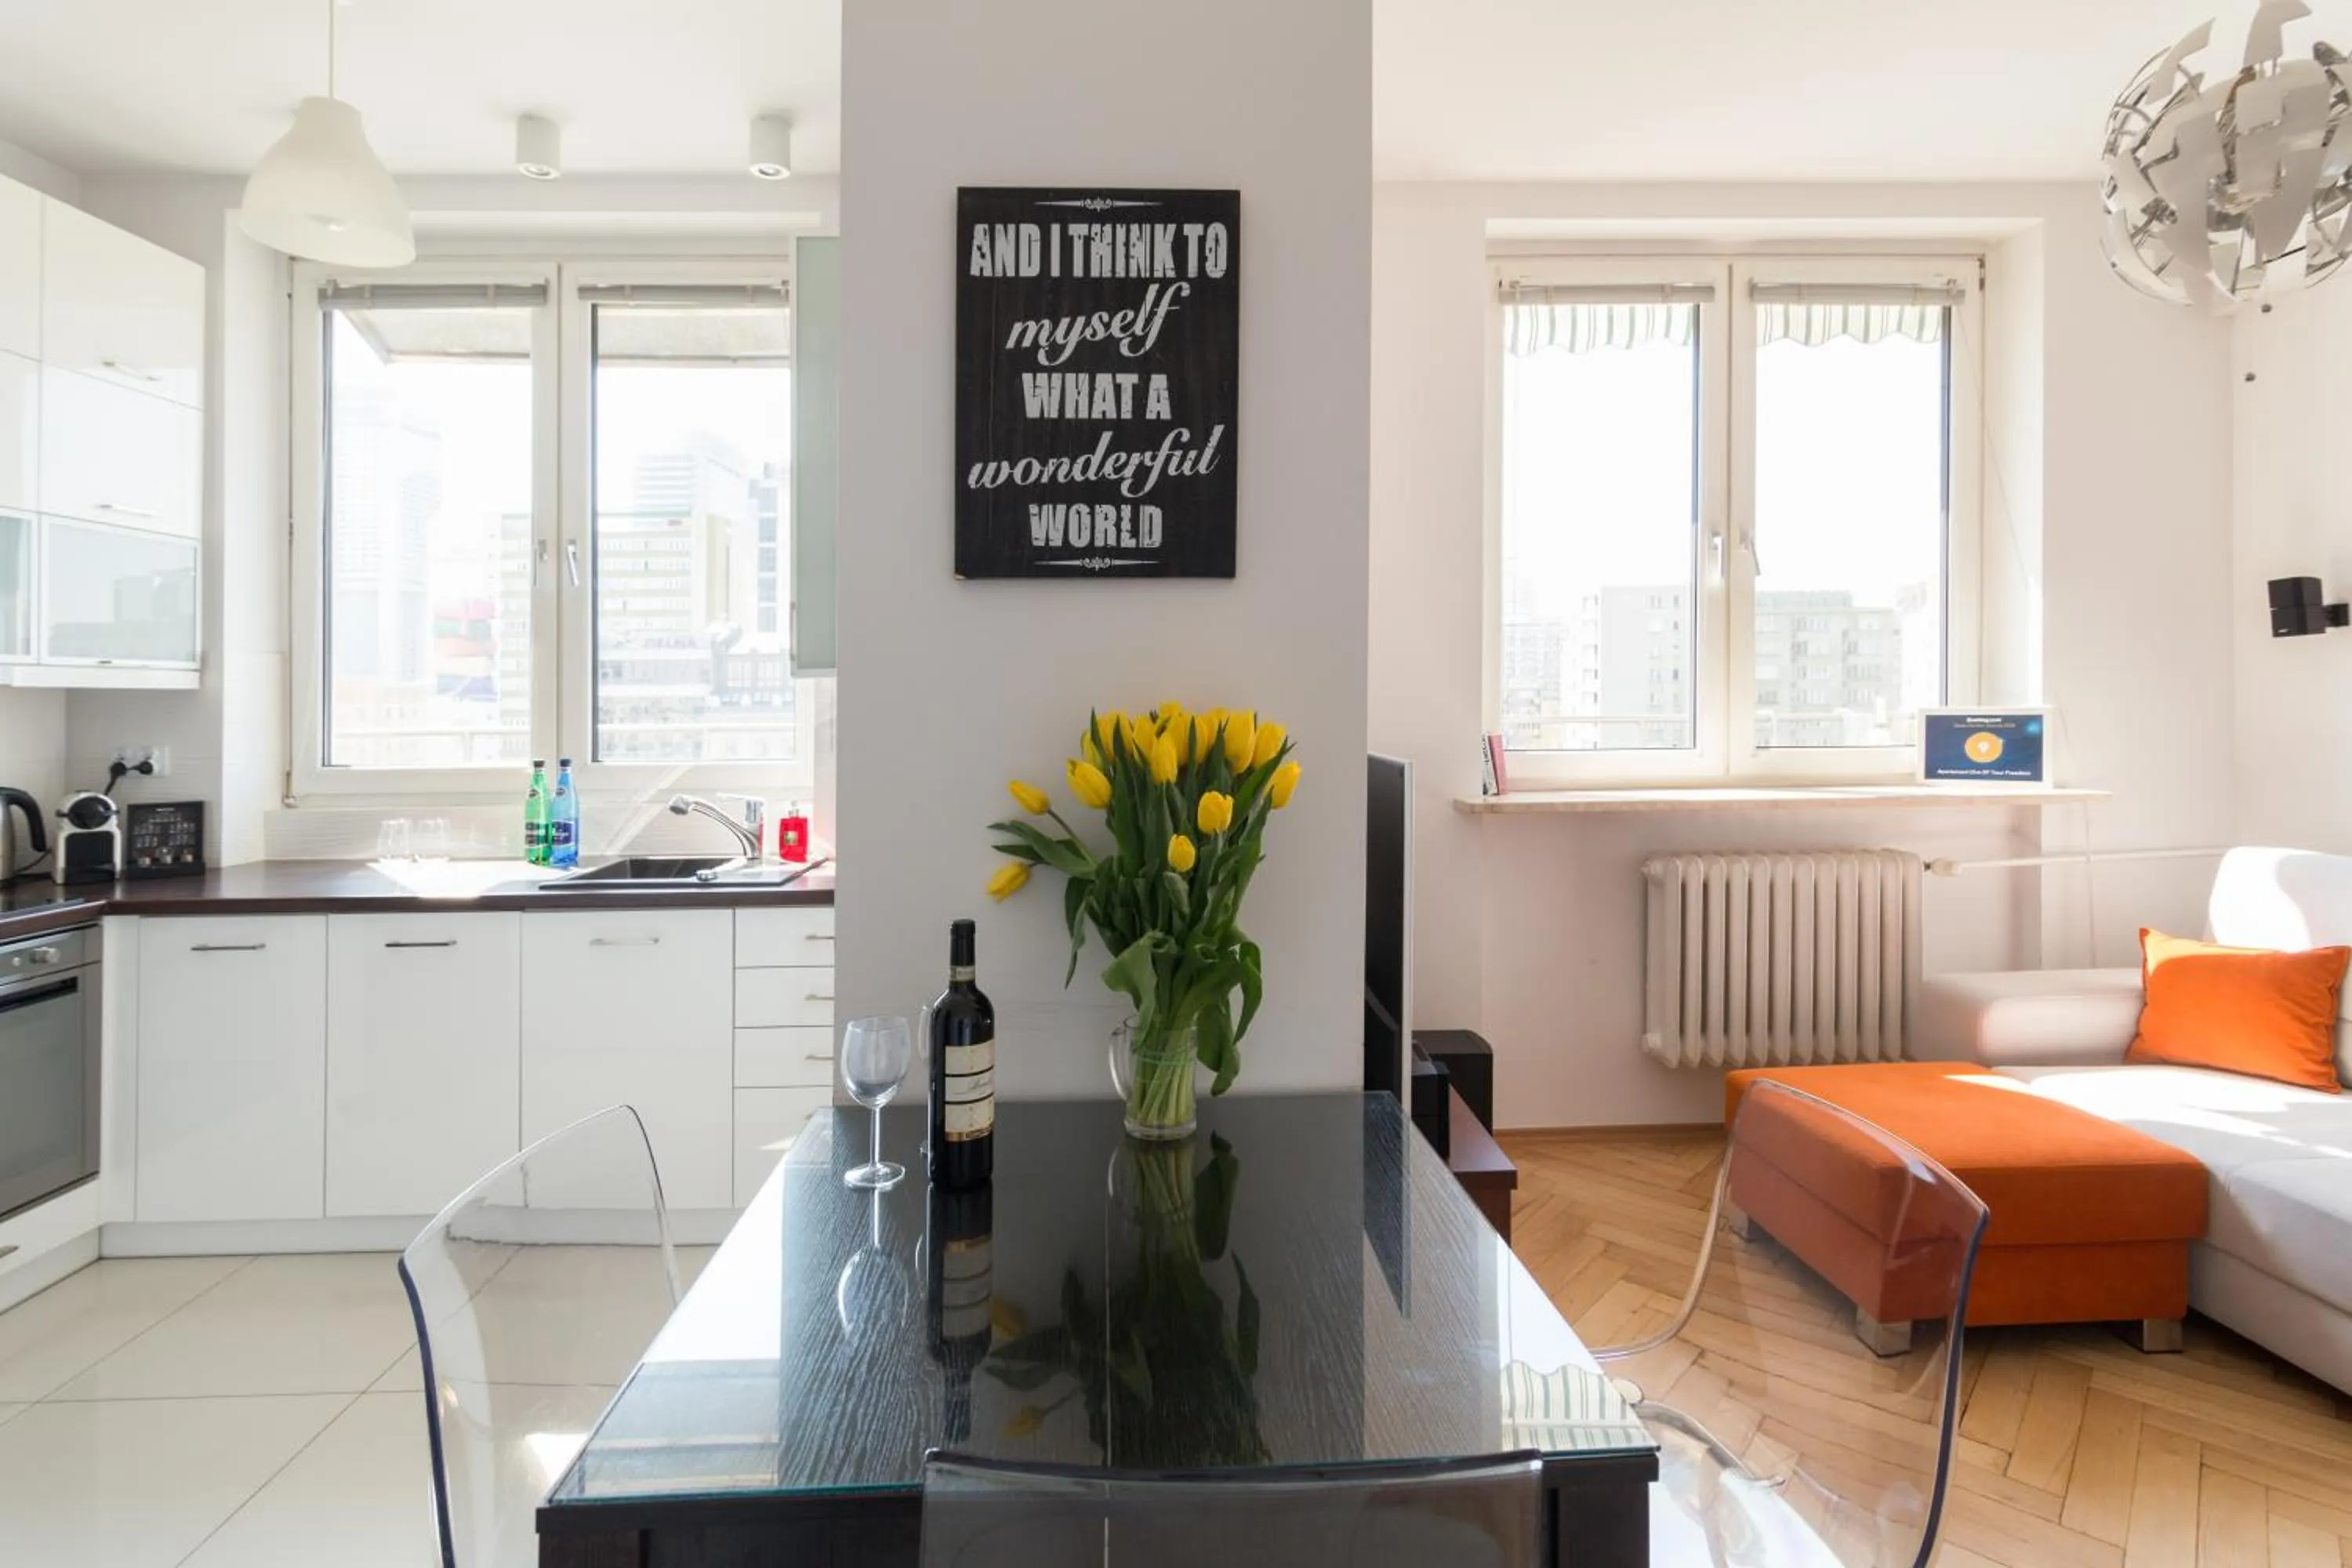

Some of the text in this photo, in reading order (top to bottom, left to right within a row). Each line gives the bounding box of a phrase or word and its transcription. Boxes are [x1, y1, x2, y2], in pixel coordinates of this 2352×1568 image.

[970, 222, 1228, 278] AND I THINK TO
[1005, 281, 1191, 366] myself
[1022, 372, 1171, 420] WHAT A
[967, 424, 1225, 498] wonderful
[1029, 503, 1163, 548] WORLD
